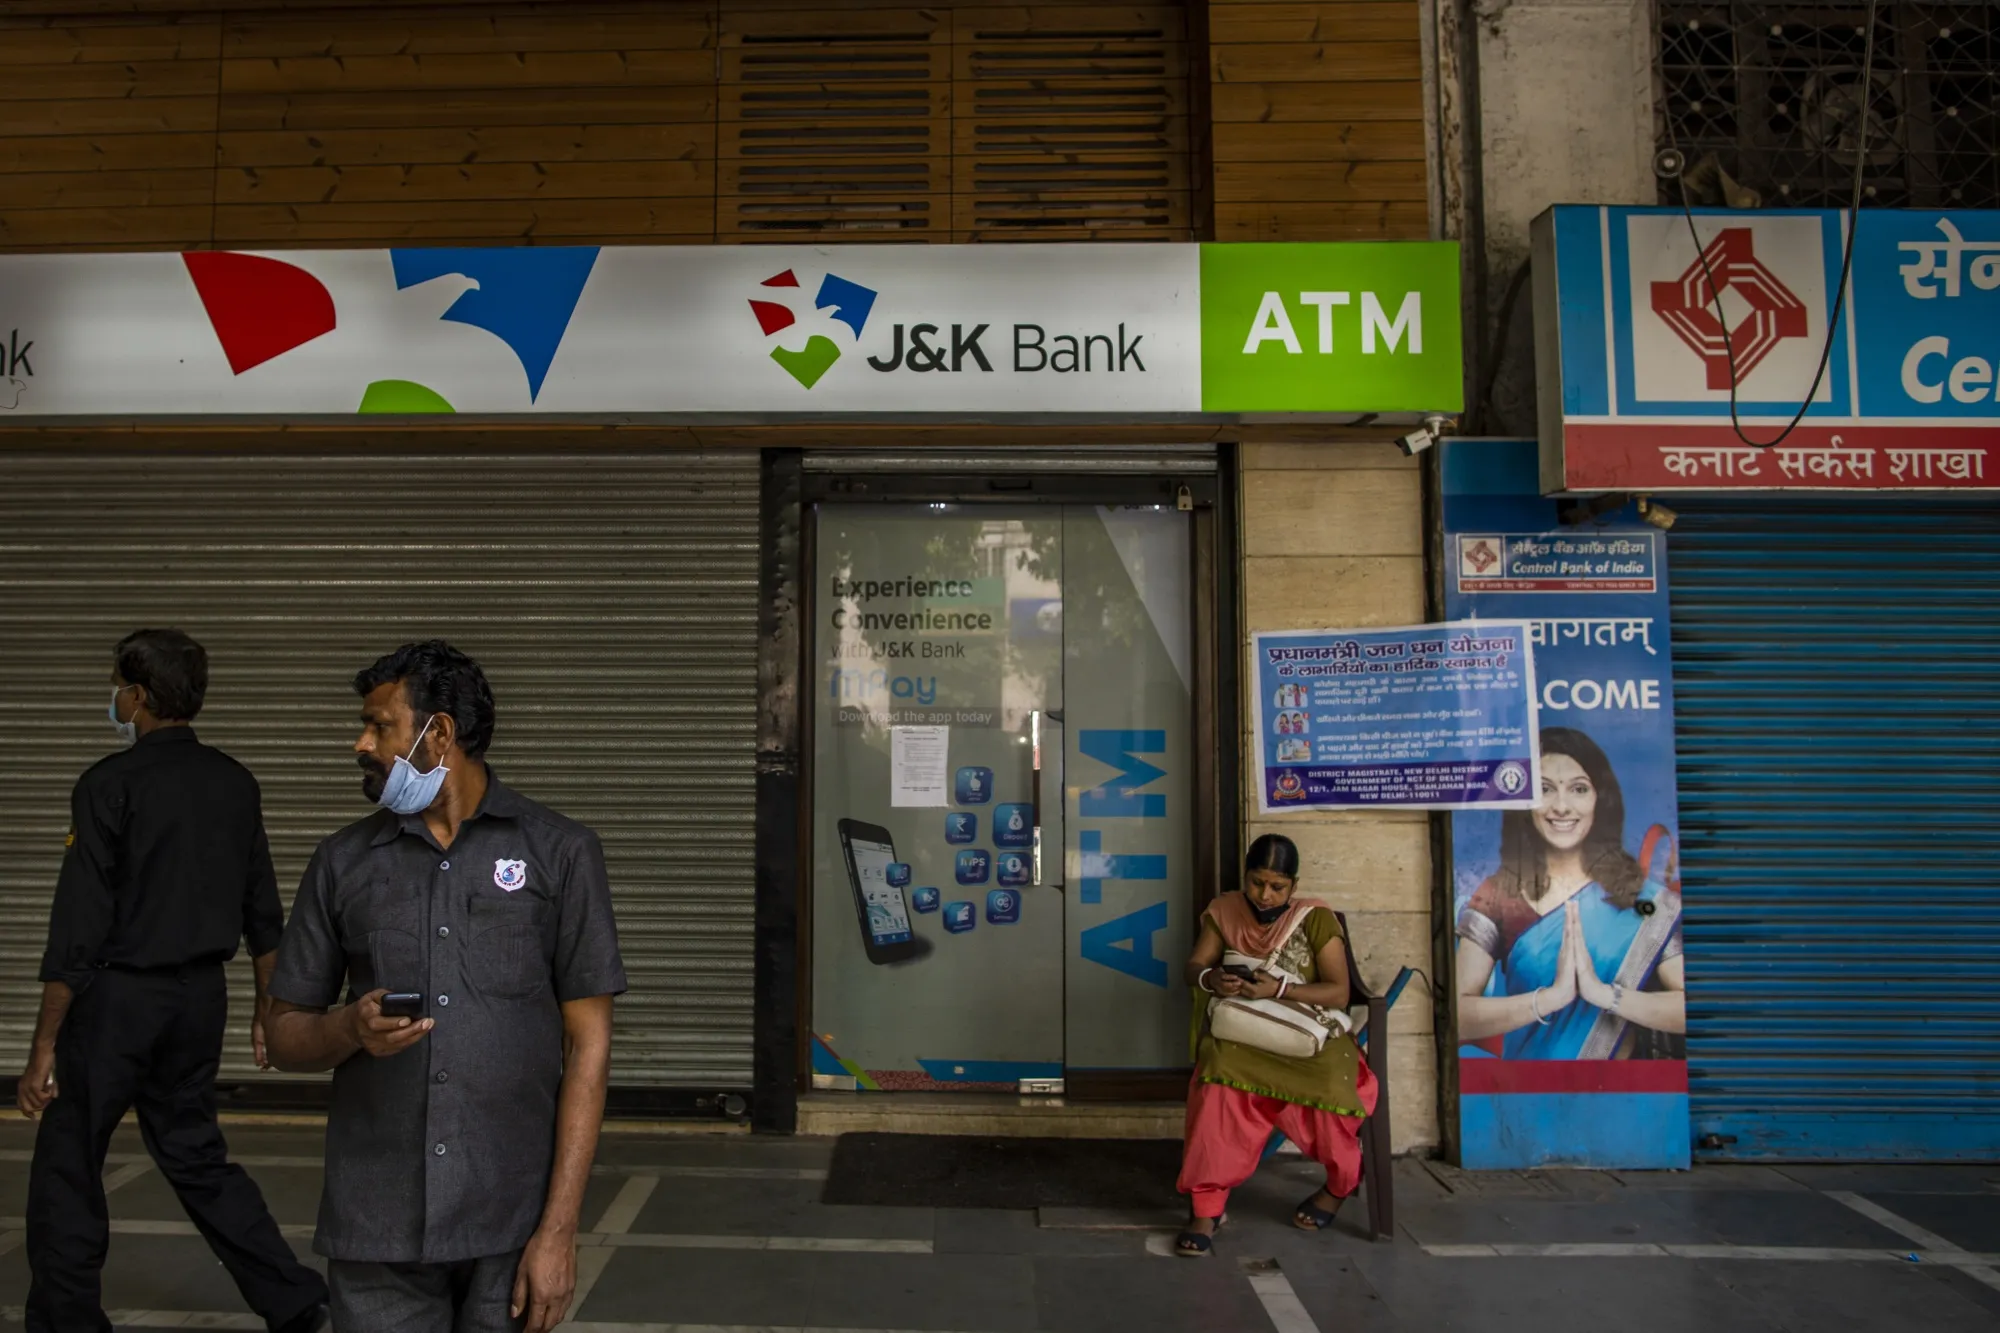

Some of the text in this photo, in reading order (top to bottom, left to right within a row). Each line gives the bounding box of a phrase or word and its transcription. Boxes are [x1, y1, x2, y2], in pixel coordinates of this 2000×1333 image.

[1242, 291, 1423, 354] ATM
[0, 328, 33, 376] k
[867, 322, 1147, 373] J&K Bank
[1658, 435, 1988, 481] कनाट सर्कस शाखा
[1512, 560, 1645, 574] Central Bank of India
[832, 576, 973, 601] Experience
[831, 608, 992, 630] Convenience
[831, 641, 965, 658] with J&K Bank
[1268, 635, 1514, 663] प्रधानमंत्री जन धन योजना
[1530, 618, 1657, 655] वागतम्
[1279, 664, 1294, 676] के
[1368, 663, 1388, 674] का
[1393, 656, 1439, 673] हार्दिक
[1444, 657, 1491, 670] स्वागत
[1495, 654, 1507, 668] है
[1537, 679, 1660, 710] COME
[839, 710, 992, 727] Download the app today
[1308, 770, 1346, 778] DISTRICT
[1404, 767, 1423, 775] NEW
[1425, 766, 1450, 775] DELHI
[1452, 765, 1488, 774] DISTRICT
[1407, 775, 1423, 783] NCT
[1439, 774, 1464, 782] DELHI
[1080, 730, 1169, 988] ATM
